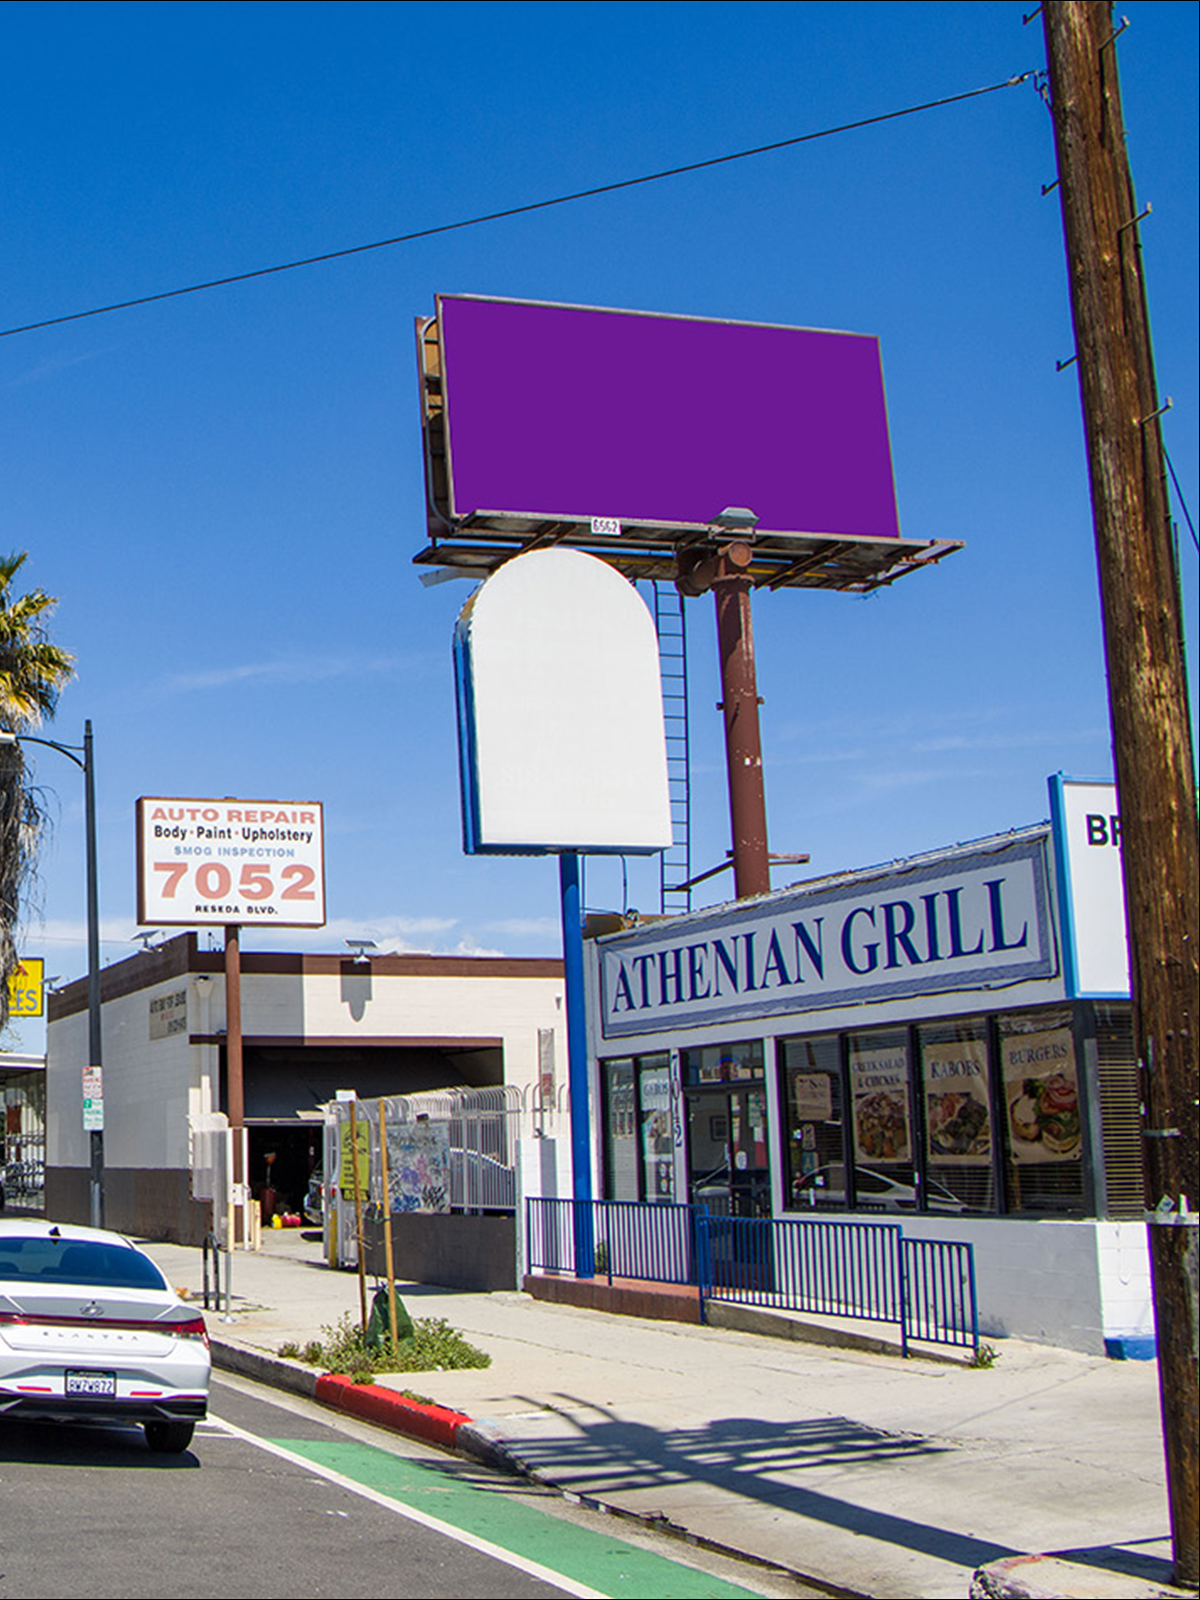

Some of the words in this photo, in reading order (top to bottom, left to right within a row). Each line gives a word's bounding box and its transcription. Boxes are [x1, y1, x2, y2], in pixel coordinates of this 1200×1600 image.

[151, 807, 220, 822] AUTO
[227, 809, 316, 825] REPAIR
[154, 825, 188, 841] Body
[196, 826, 233, 840] Paint
[241, 827, 313, 844] Upholstery
[174, 846, 213, 856] SMOG
[218, 846, 295, 858] INSPECTION
[153, 861, 316, 901] 7052
[195, 904, 240, 914] RESEDA
[612, 916, 825, 1014] ATHENIAN
[840, 878, 1029, 976] GRILL
[1010, 1042, 1068, 1065] BURGERS
[930, 1059, 981, 1079] KABOBS
